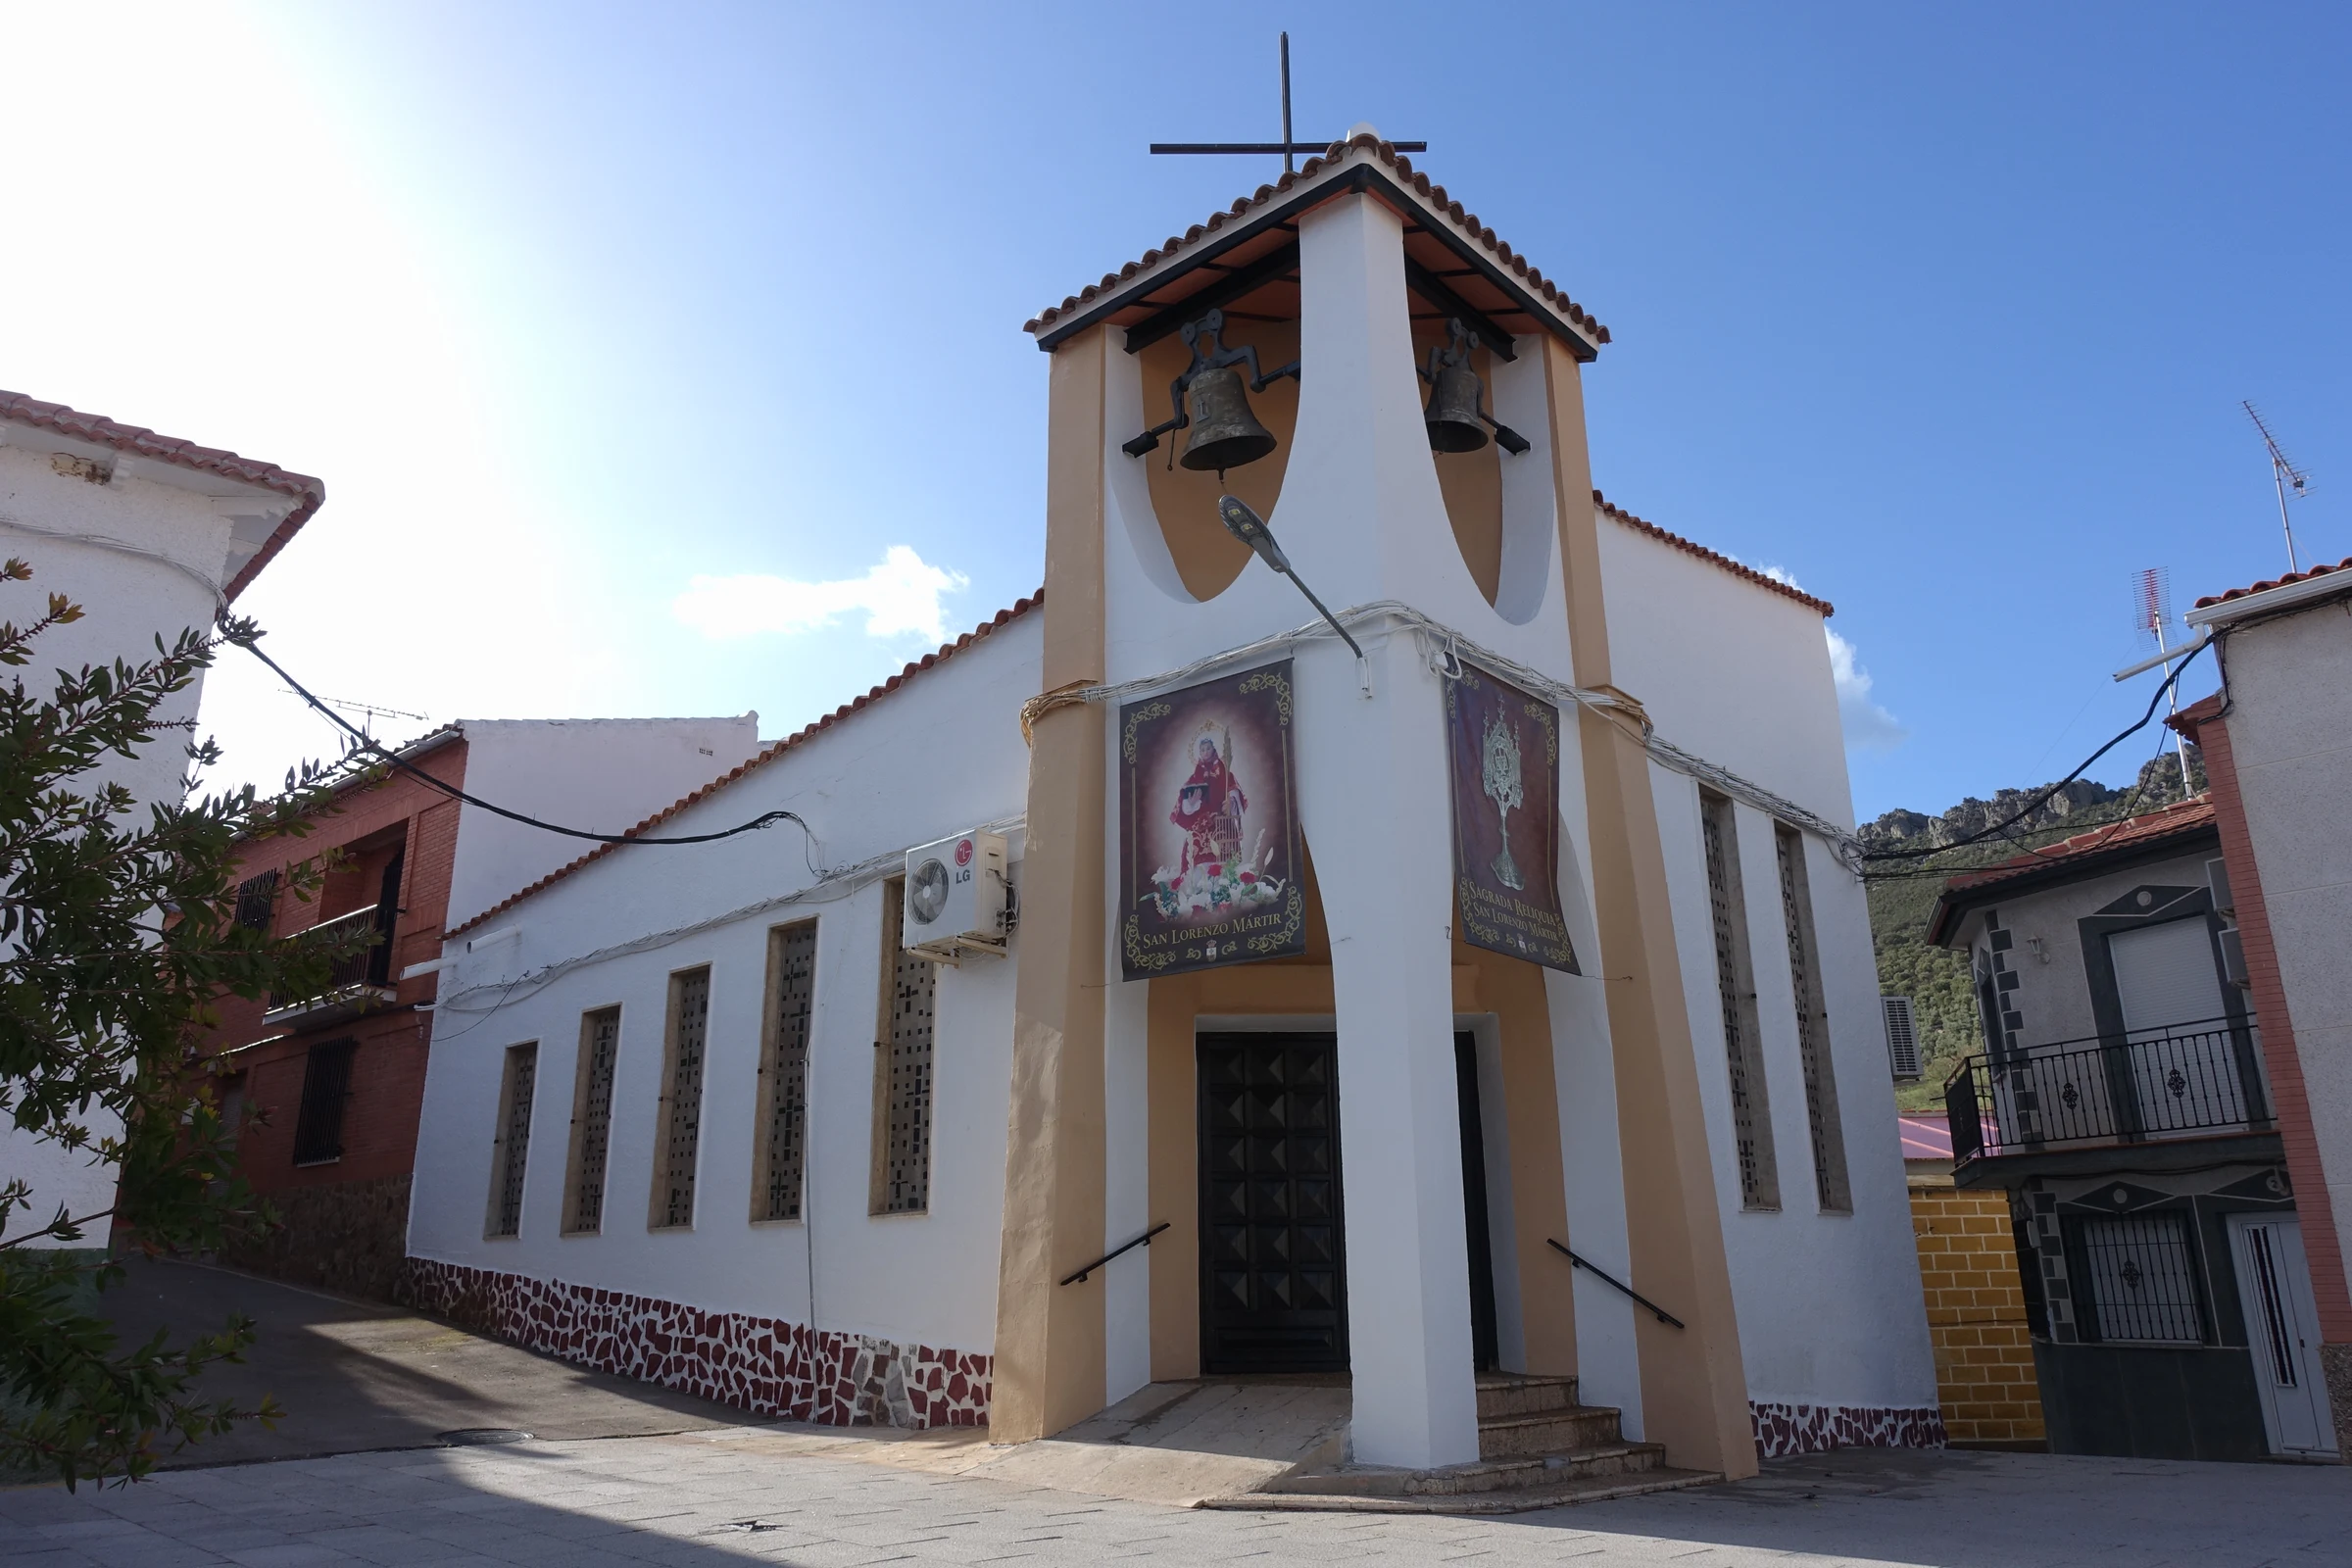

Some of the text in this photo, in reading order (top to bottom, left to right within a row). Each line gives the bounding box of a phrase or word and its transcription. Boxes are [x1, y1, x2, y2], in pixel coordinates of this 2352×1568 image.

[956, 869, 970, 884] LG
[1469, 881, 1556, 926] SAGRADA RELIQUIA
[1473, 902, 1491, 918] SAN
[1492, 907, 1528, 931] LORENZO
[1143, 913, 1282, 949] SAN LORENZO MÁRTIR
